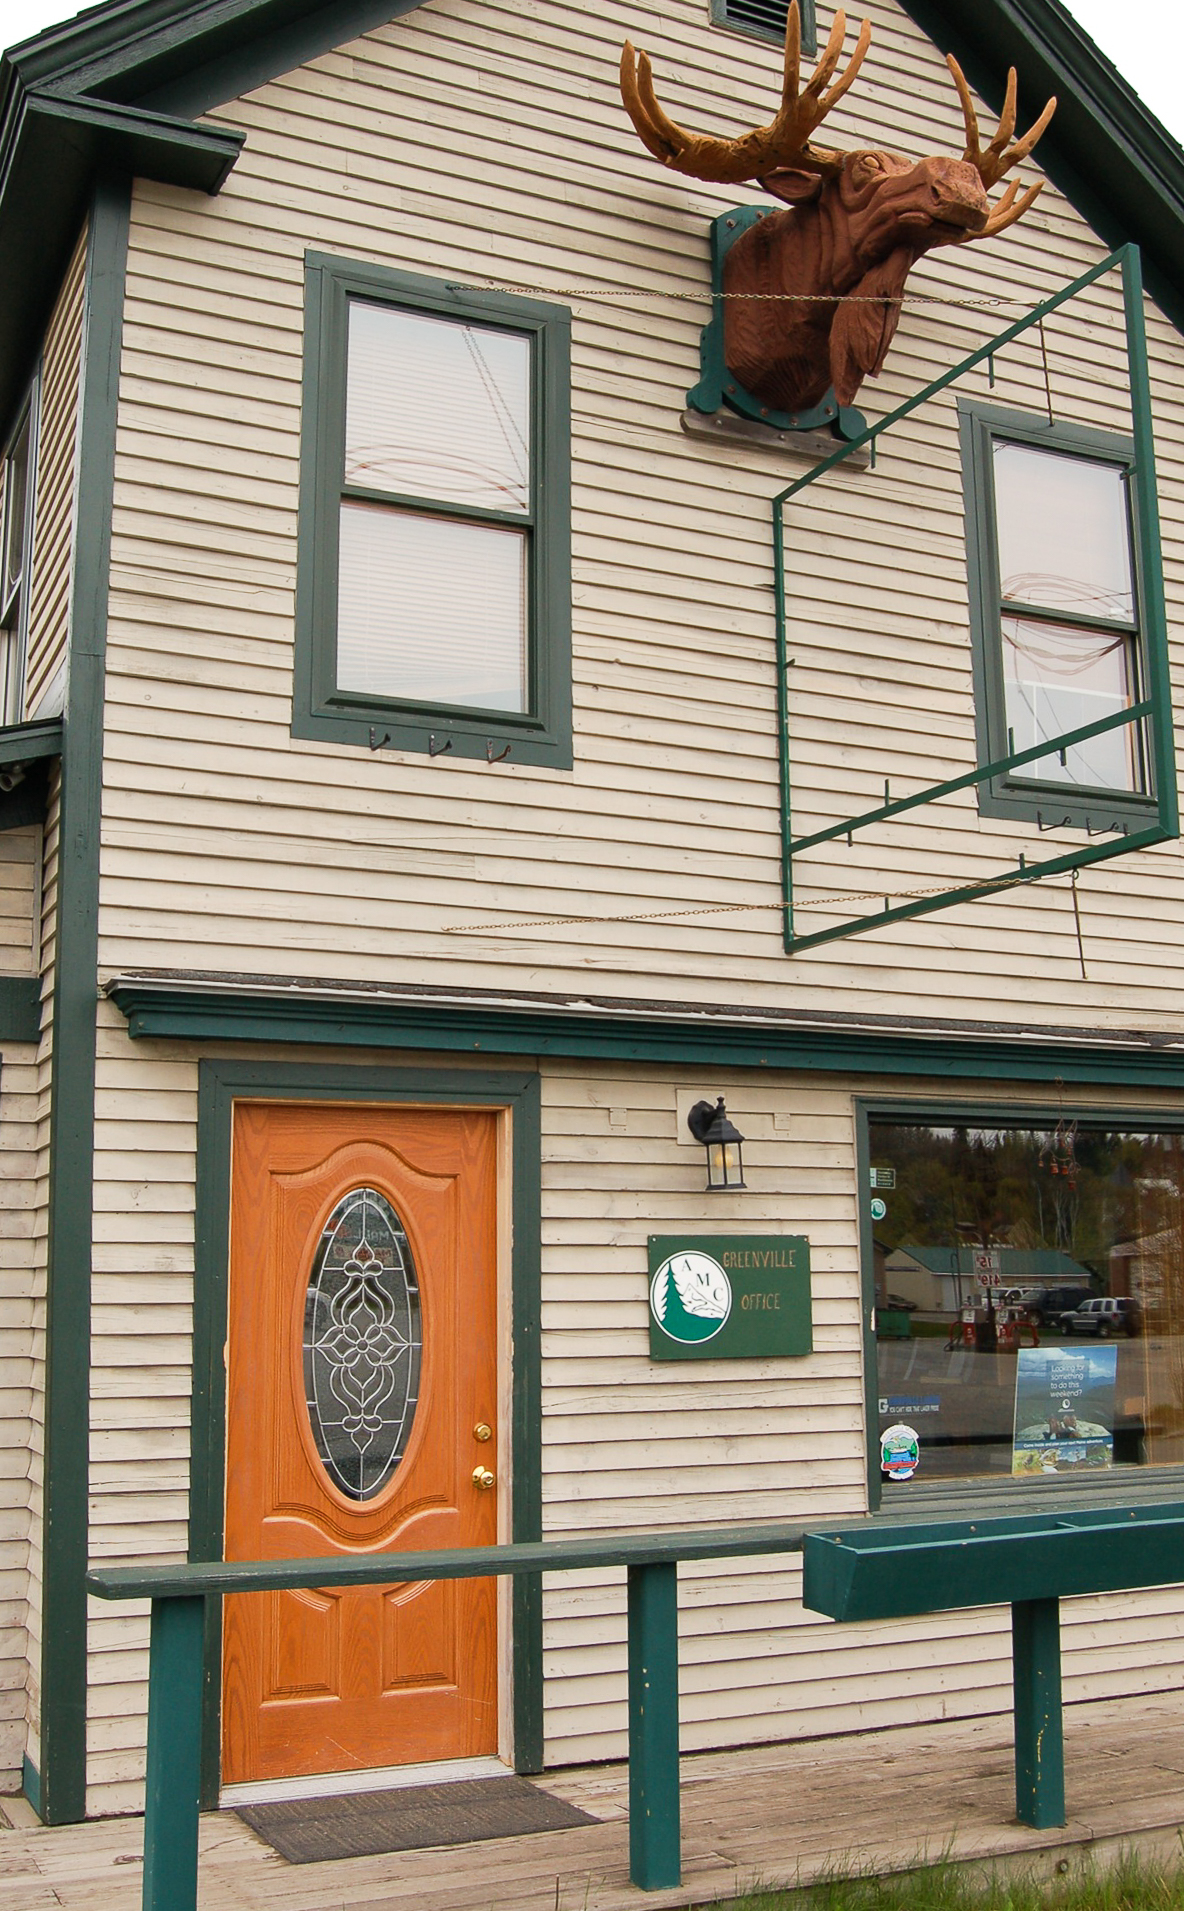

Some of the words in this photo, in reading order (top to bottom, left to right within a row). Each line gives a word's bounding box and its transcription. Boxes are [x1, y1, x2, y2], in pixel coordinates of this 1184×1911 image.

[723, 1249, 796, 1268] GREENVILLE
[741, 1293, 781, 1310] OFFICE
[1051, 1364, 1076, 1373] Looking
[1051, 1372, 1083, 1380] something
[1058, 1381, 1067, 1389] do
[1068, 1381, 1080, 1389] this
[1050, 1389, 1082, 1398] weekend?
